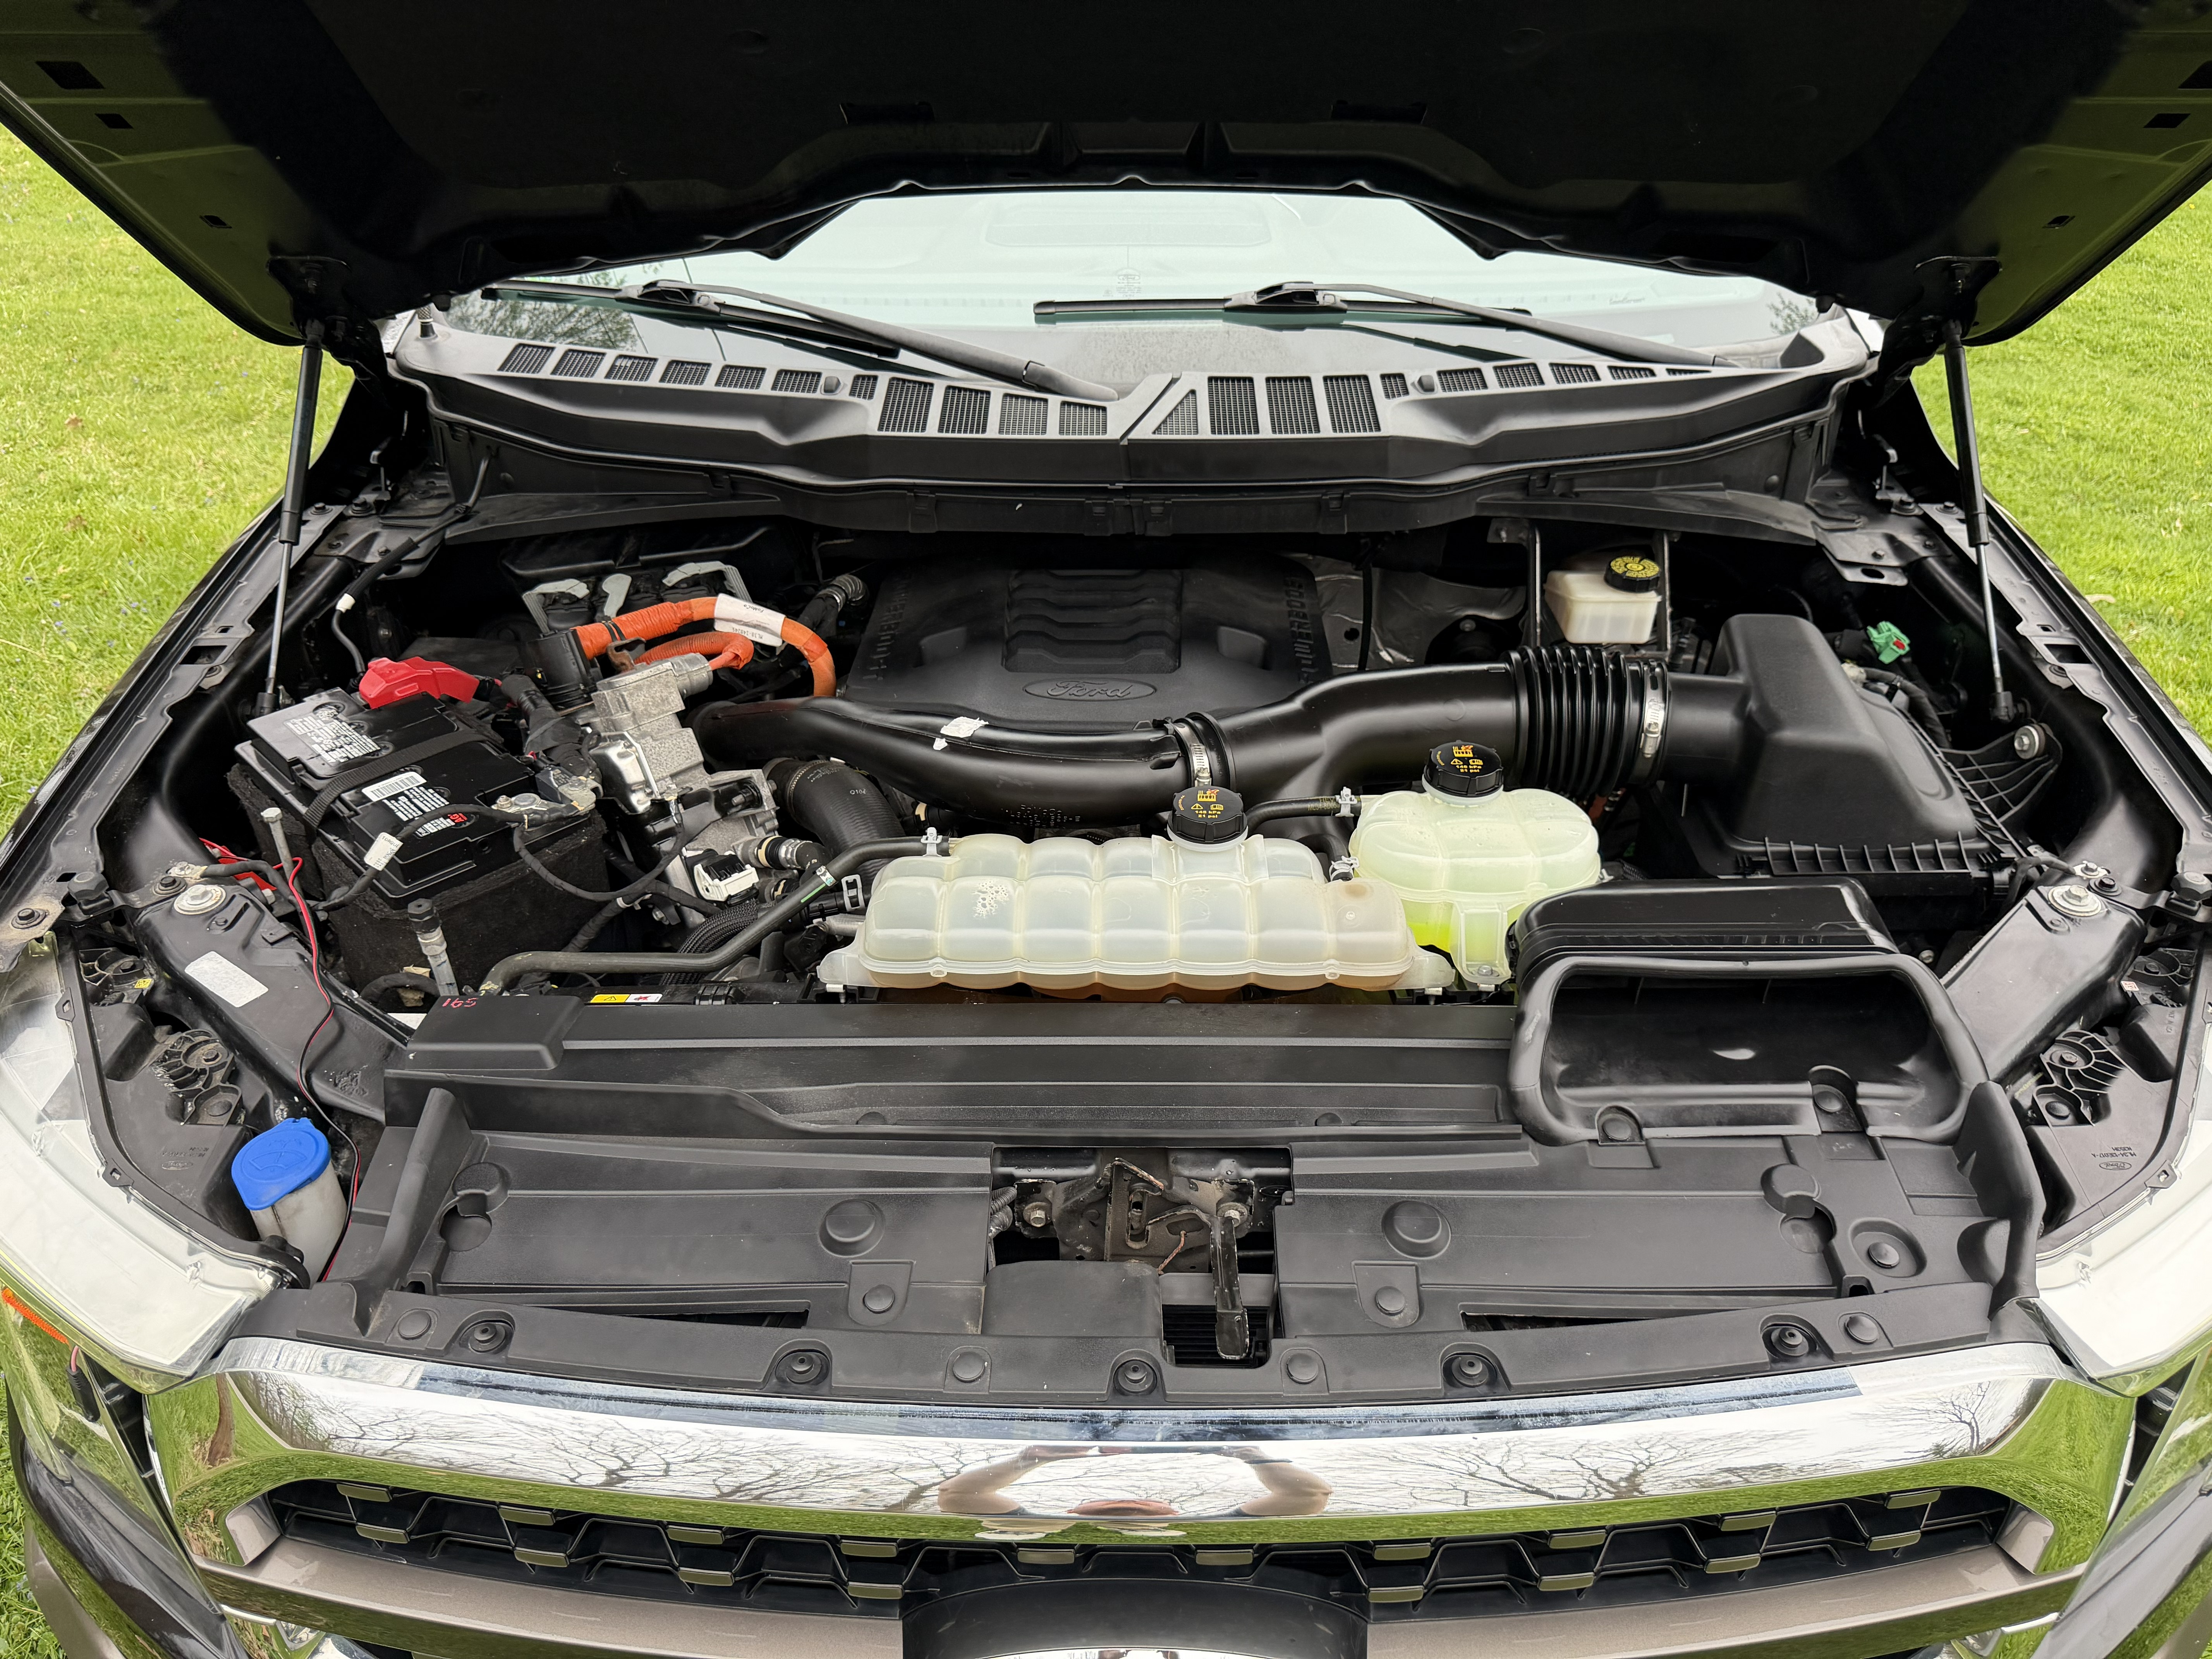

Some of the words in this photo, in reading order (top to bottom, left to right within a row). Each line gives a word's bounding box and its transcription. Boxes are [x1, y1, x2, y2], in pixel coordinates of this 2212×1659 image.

[1283, 573, 1317, 685] POWERBOOS
[1047, 681, 1133, 697] Ford
[448, 814, 464, 822] AG
[442, 998, 478, 1008] 165
